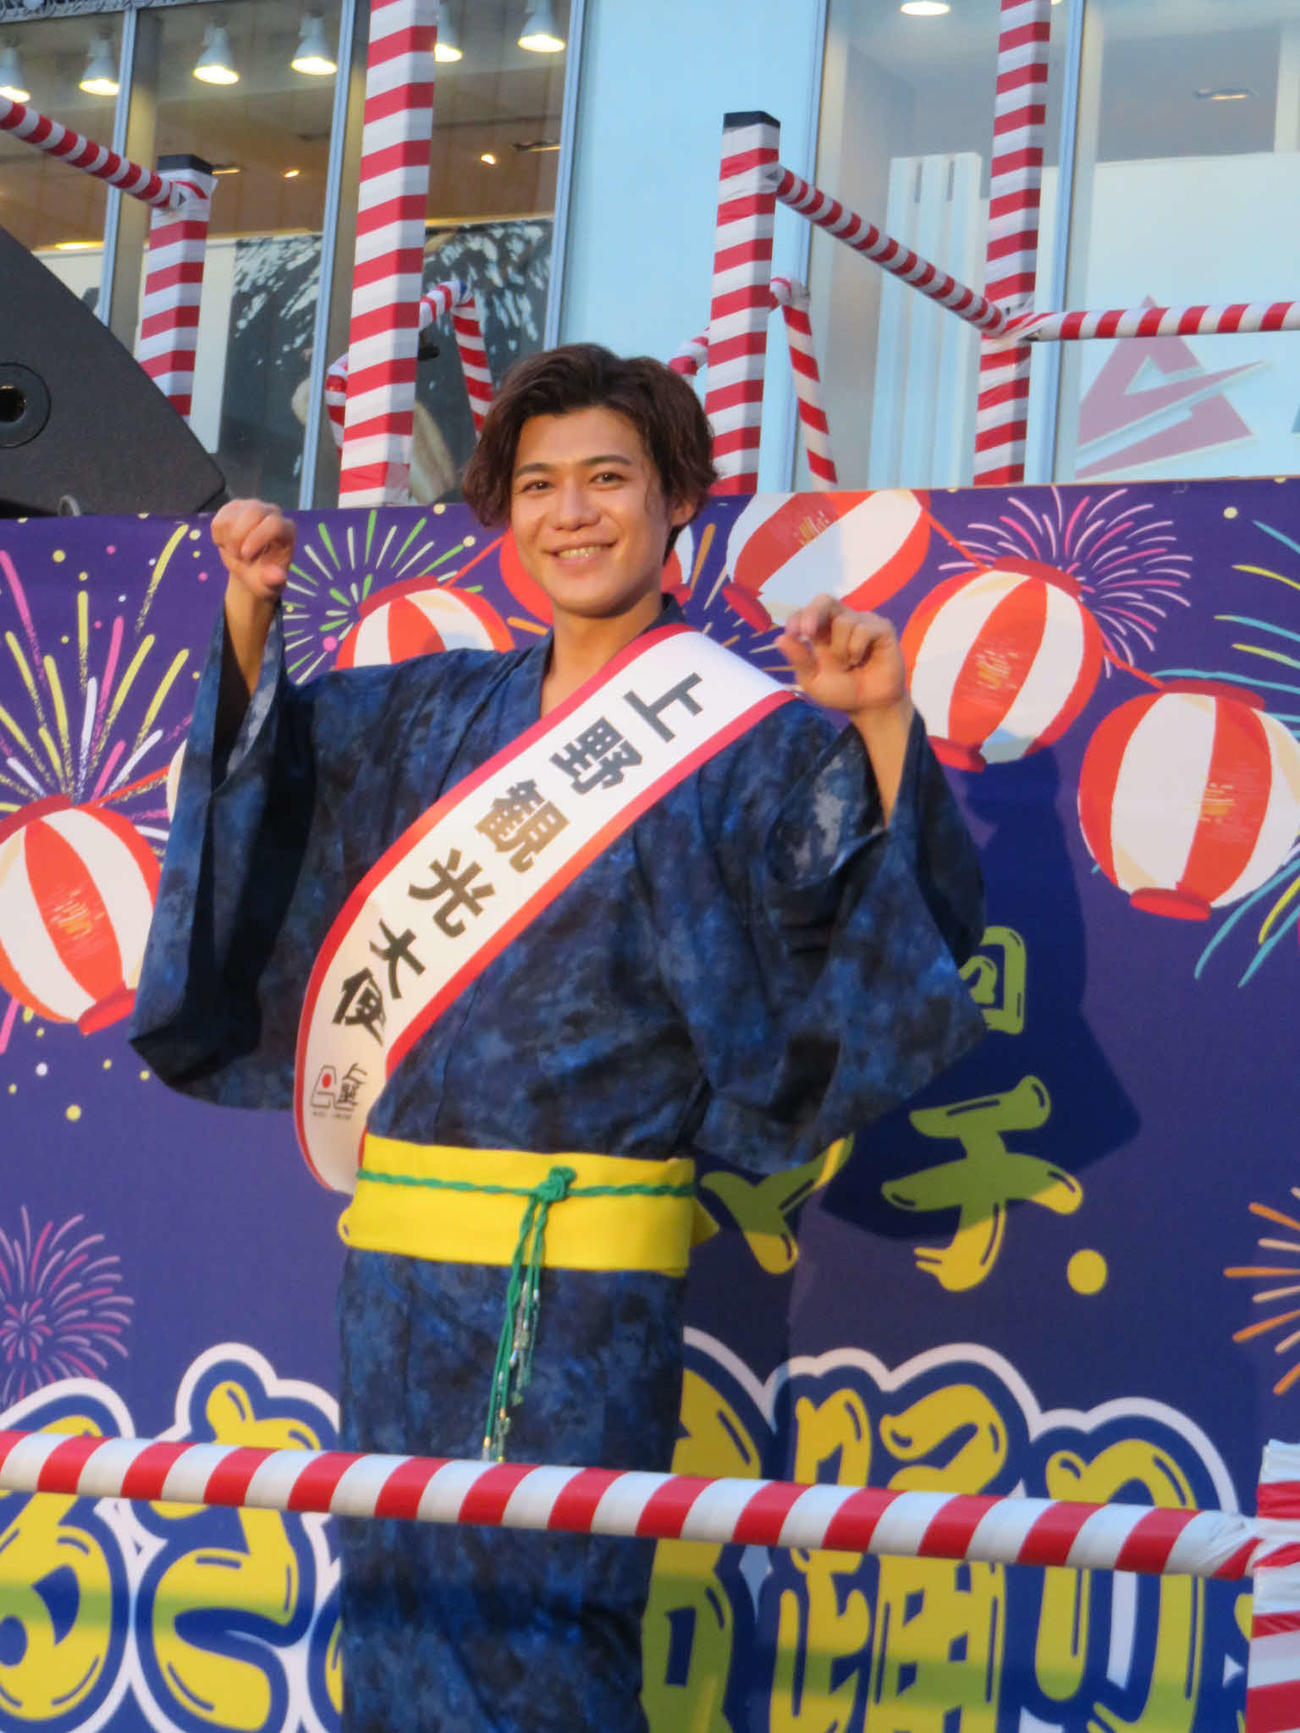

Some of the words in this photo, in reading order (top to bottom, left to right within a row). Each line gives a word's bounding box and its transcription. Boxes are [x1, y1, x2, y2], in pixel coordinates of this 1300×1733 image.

[333, 672, 703, 1046] 上野観光大使
